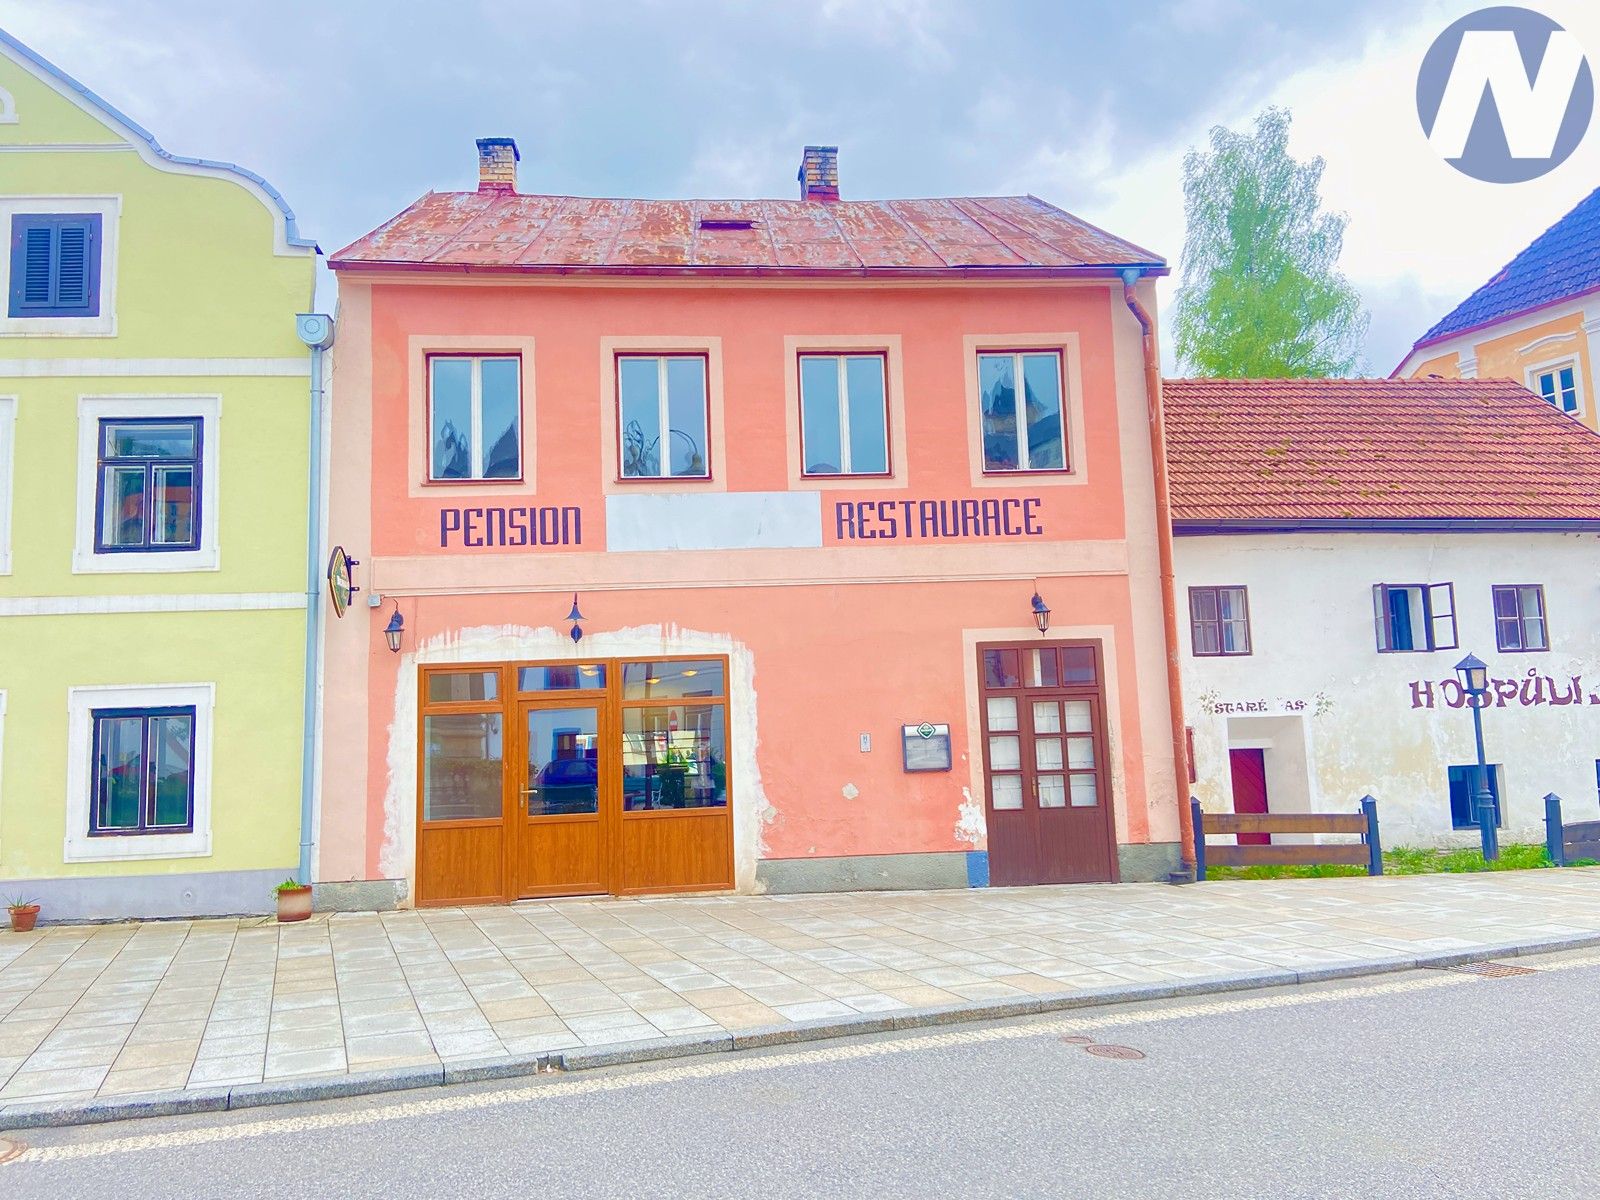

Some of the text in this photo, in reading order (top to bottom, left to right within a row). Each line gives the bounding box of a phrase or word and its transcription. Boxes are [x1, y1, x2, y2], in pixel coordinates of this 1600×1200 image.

[440, 497, 1043, 547] PENSION RESTAURACE
[1214, 698, 1268, 715] STARÉ
